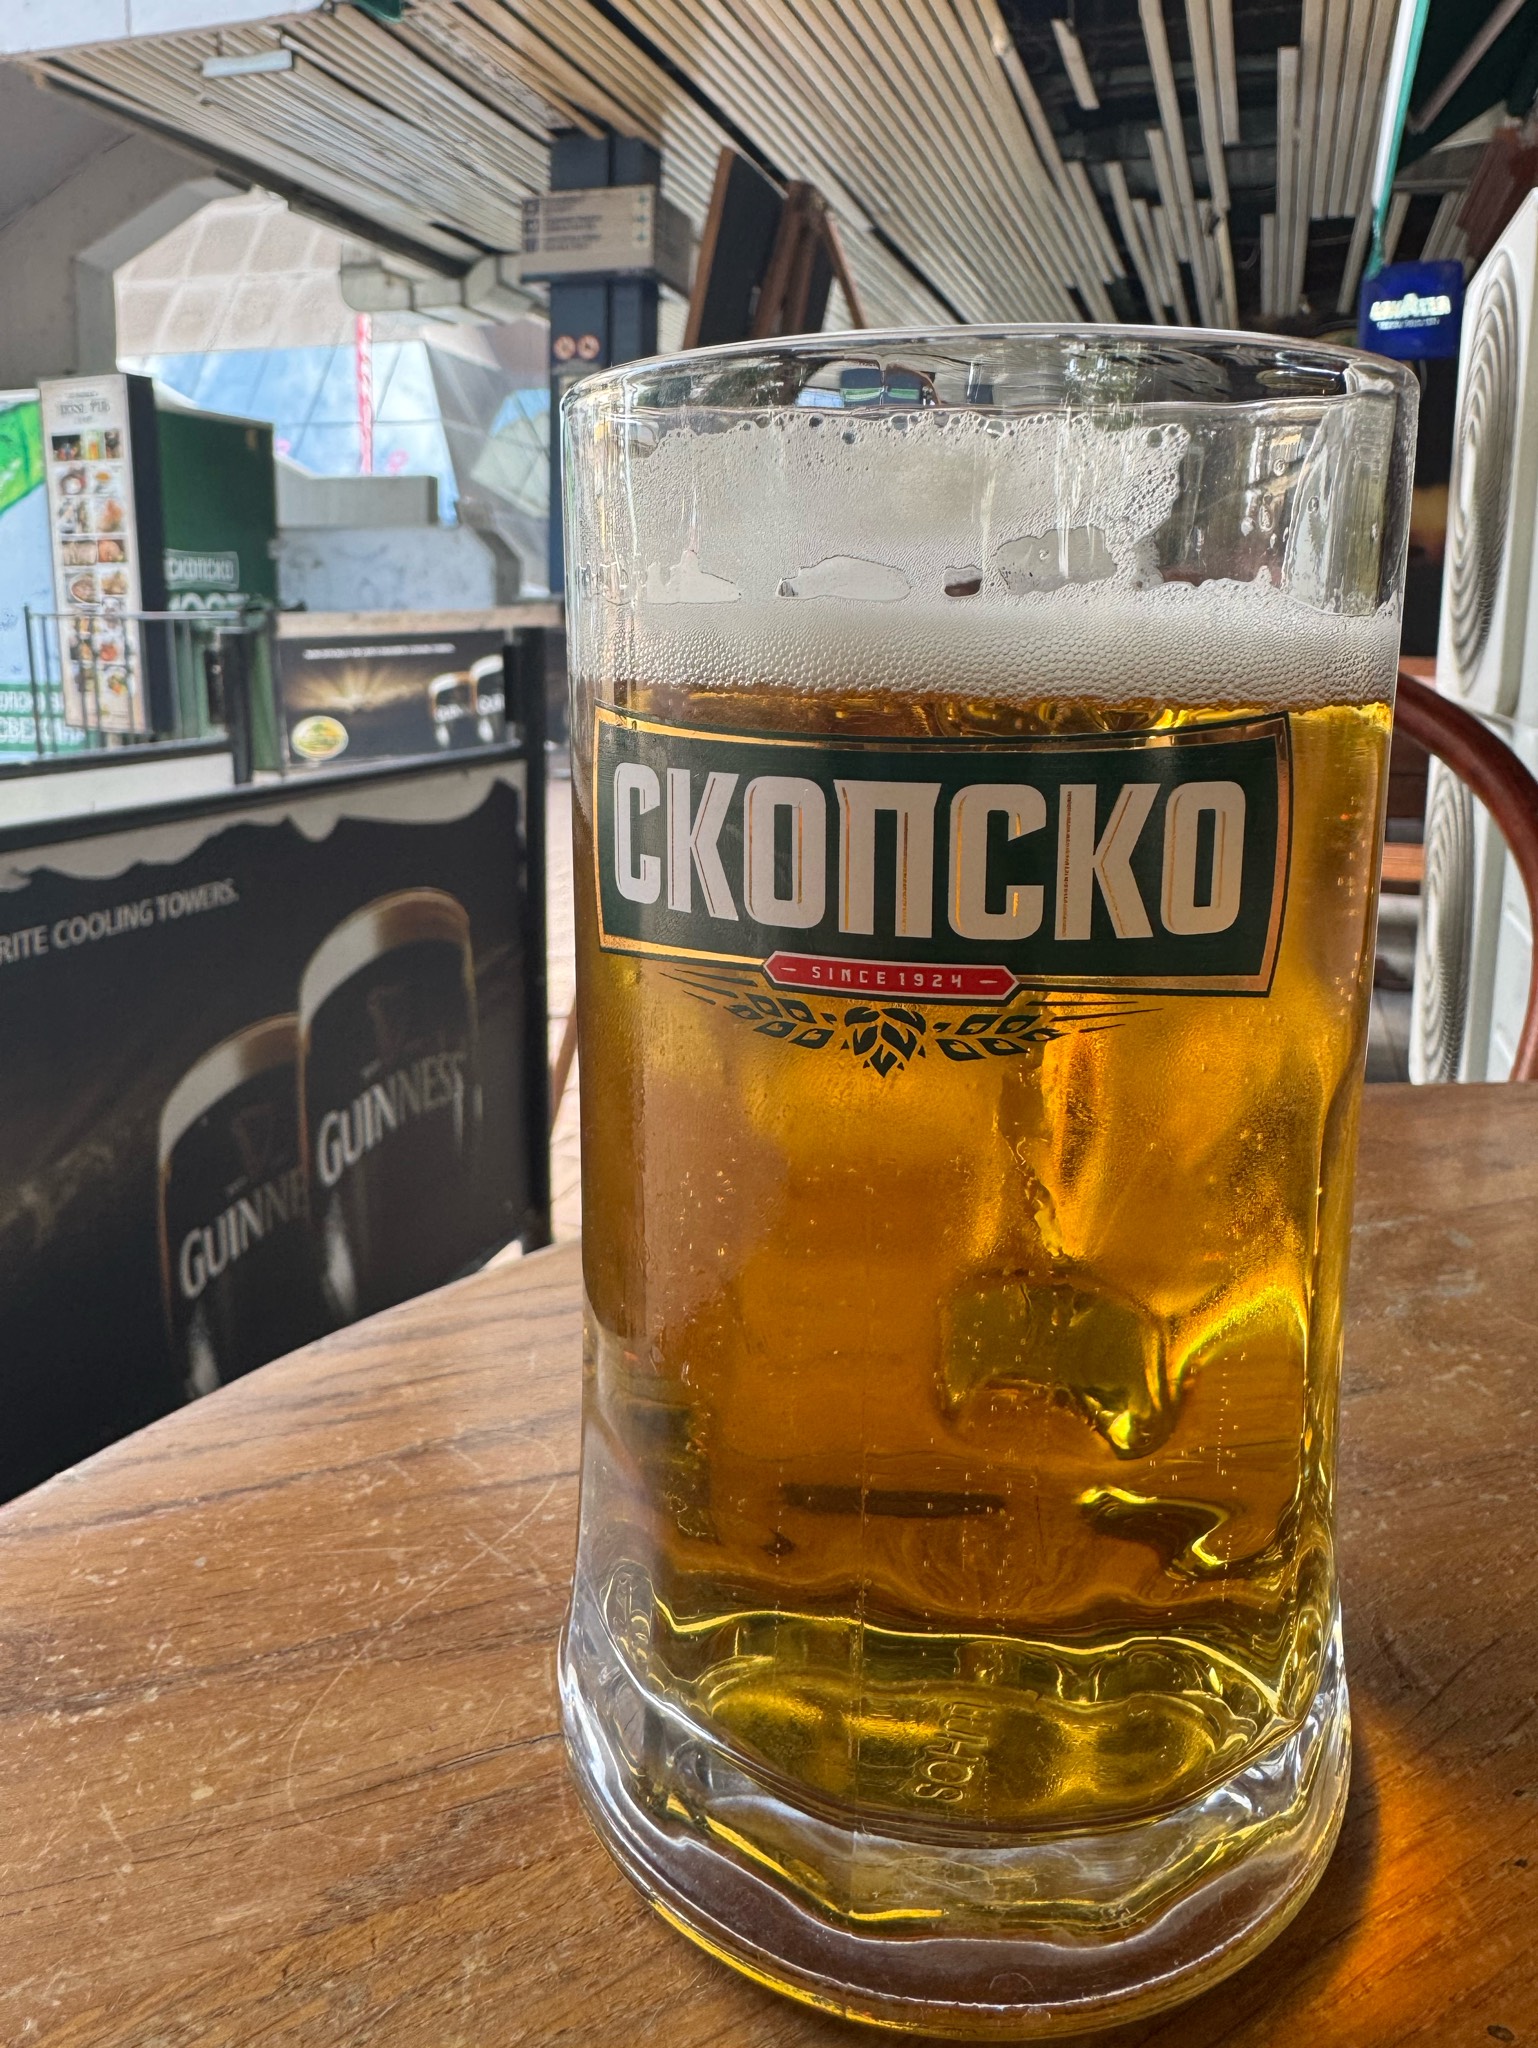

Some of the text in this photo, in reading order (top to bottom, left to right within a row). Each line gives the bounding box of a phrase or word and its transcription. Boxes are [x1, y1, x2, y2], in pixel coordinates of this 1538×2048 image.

[614, 761, 1246, 941] СКОПСКО
[53, 898, 154, 950] COOLING
[811, 966, 963, 989] SINCE 1924
